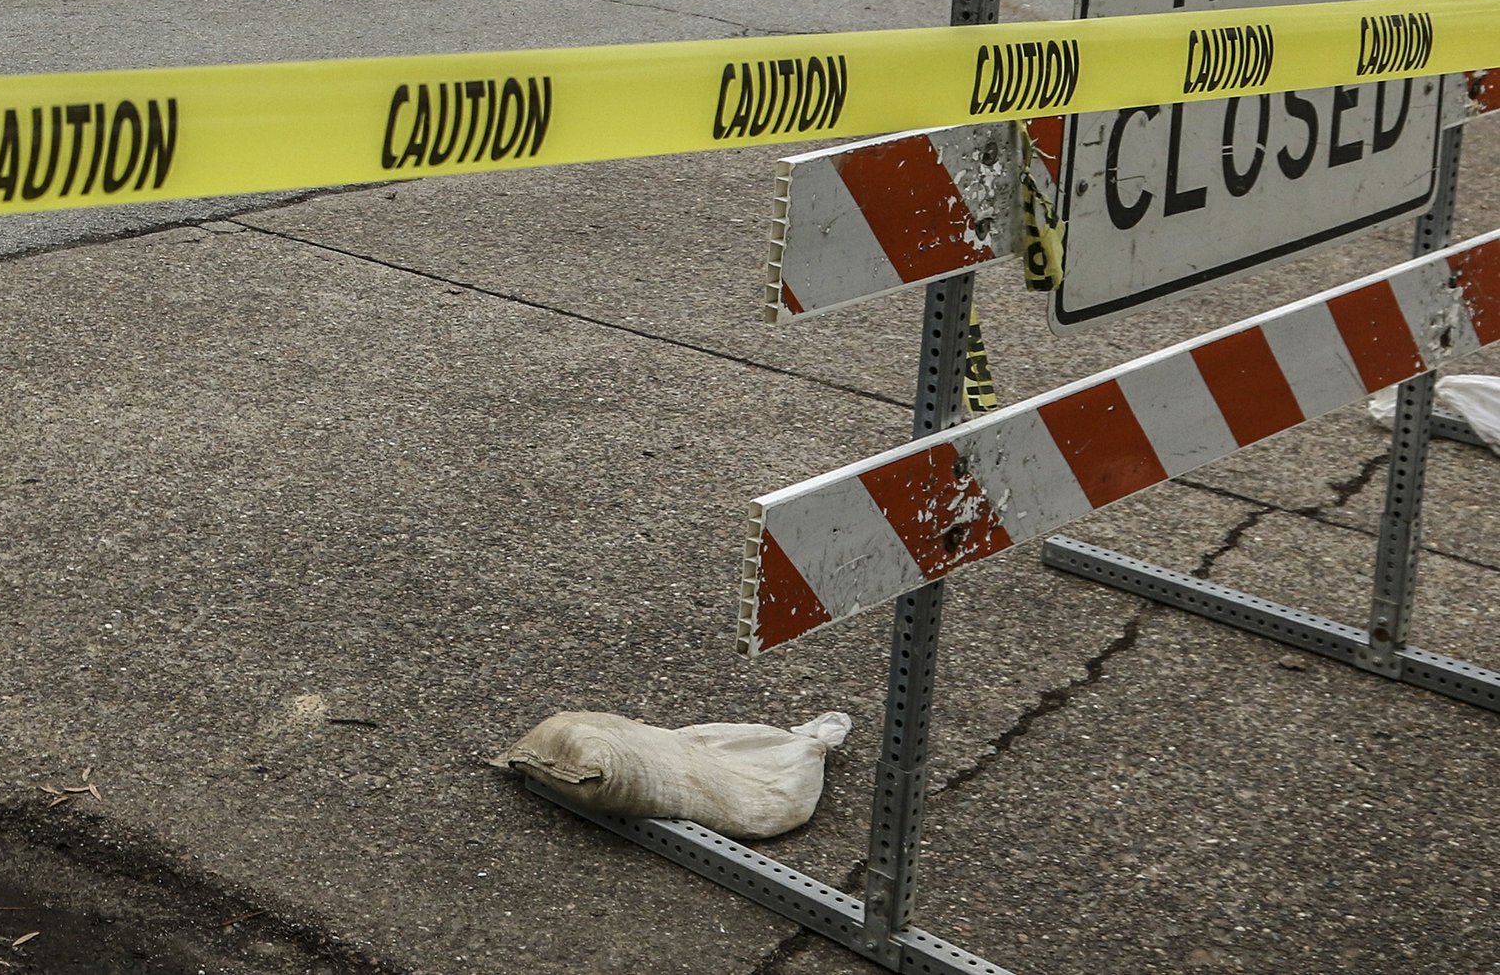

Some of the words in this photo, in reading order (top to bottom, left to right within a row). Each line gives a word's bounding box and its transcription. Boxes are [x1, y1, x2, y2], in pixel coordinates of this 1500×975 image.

[381, 76, 552, 169] CAUTION
[713, 55, 848, 140] CAUTION
[969, 39, 1080, 115] CAUTION
[1183, 25, 1274, 94] CAUTION
[1356, 12, 1433, 76] CAUTION
[1105, 77, 1413, 230] CLOSED
